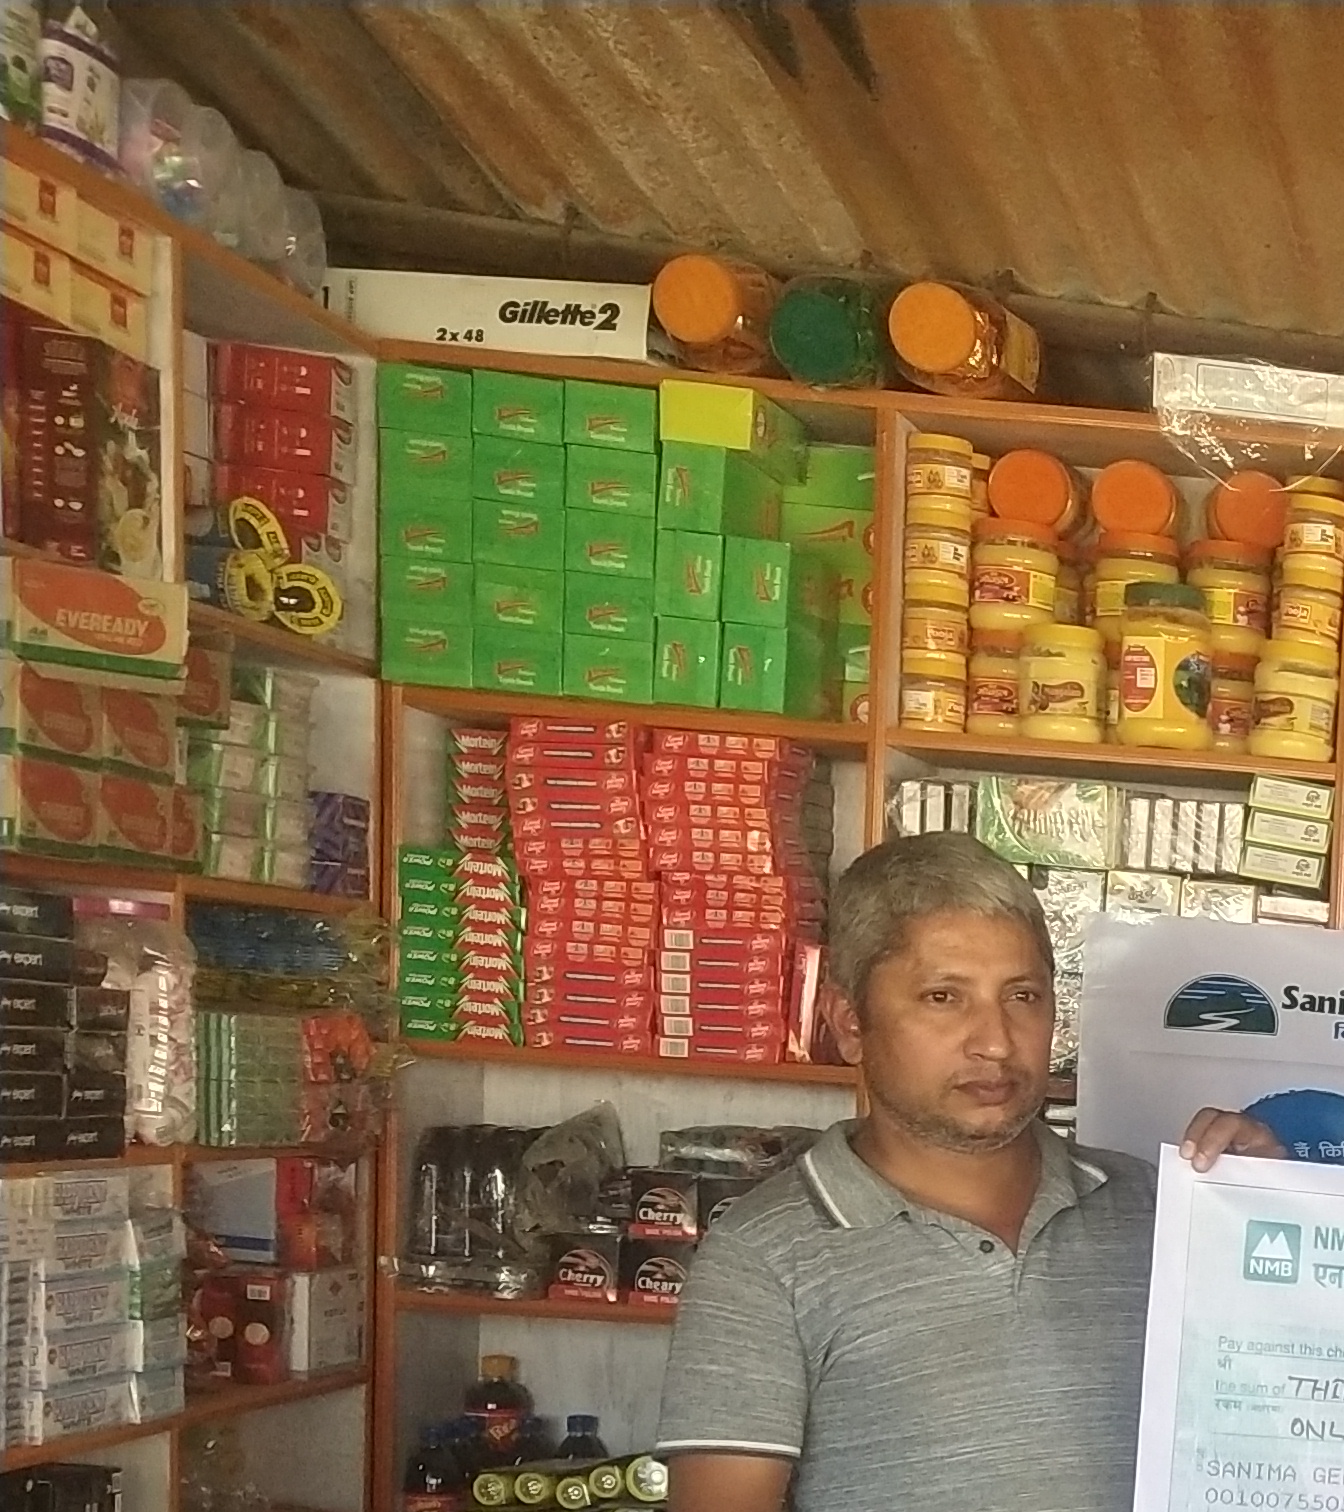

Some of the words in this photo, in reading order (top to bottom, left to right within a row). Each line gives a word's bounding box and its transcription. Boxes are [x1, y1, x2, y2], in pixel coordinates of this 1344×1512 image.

[498, 299, 595, 328] Gillette
[55, 608, 150, 637] EVEREADY
[1249, 1258, 1293, 1278] NMB
[1217, 1335, 1243, 1352] Pay
[1246, 1340, 1295, 1357] against
[1299, 1343, 1323, 1357] this
[1204, 1458, 1297, 1483] SANIMA
